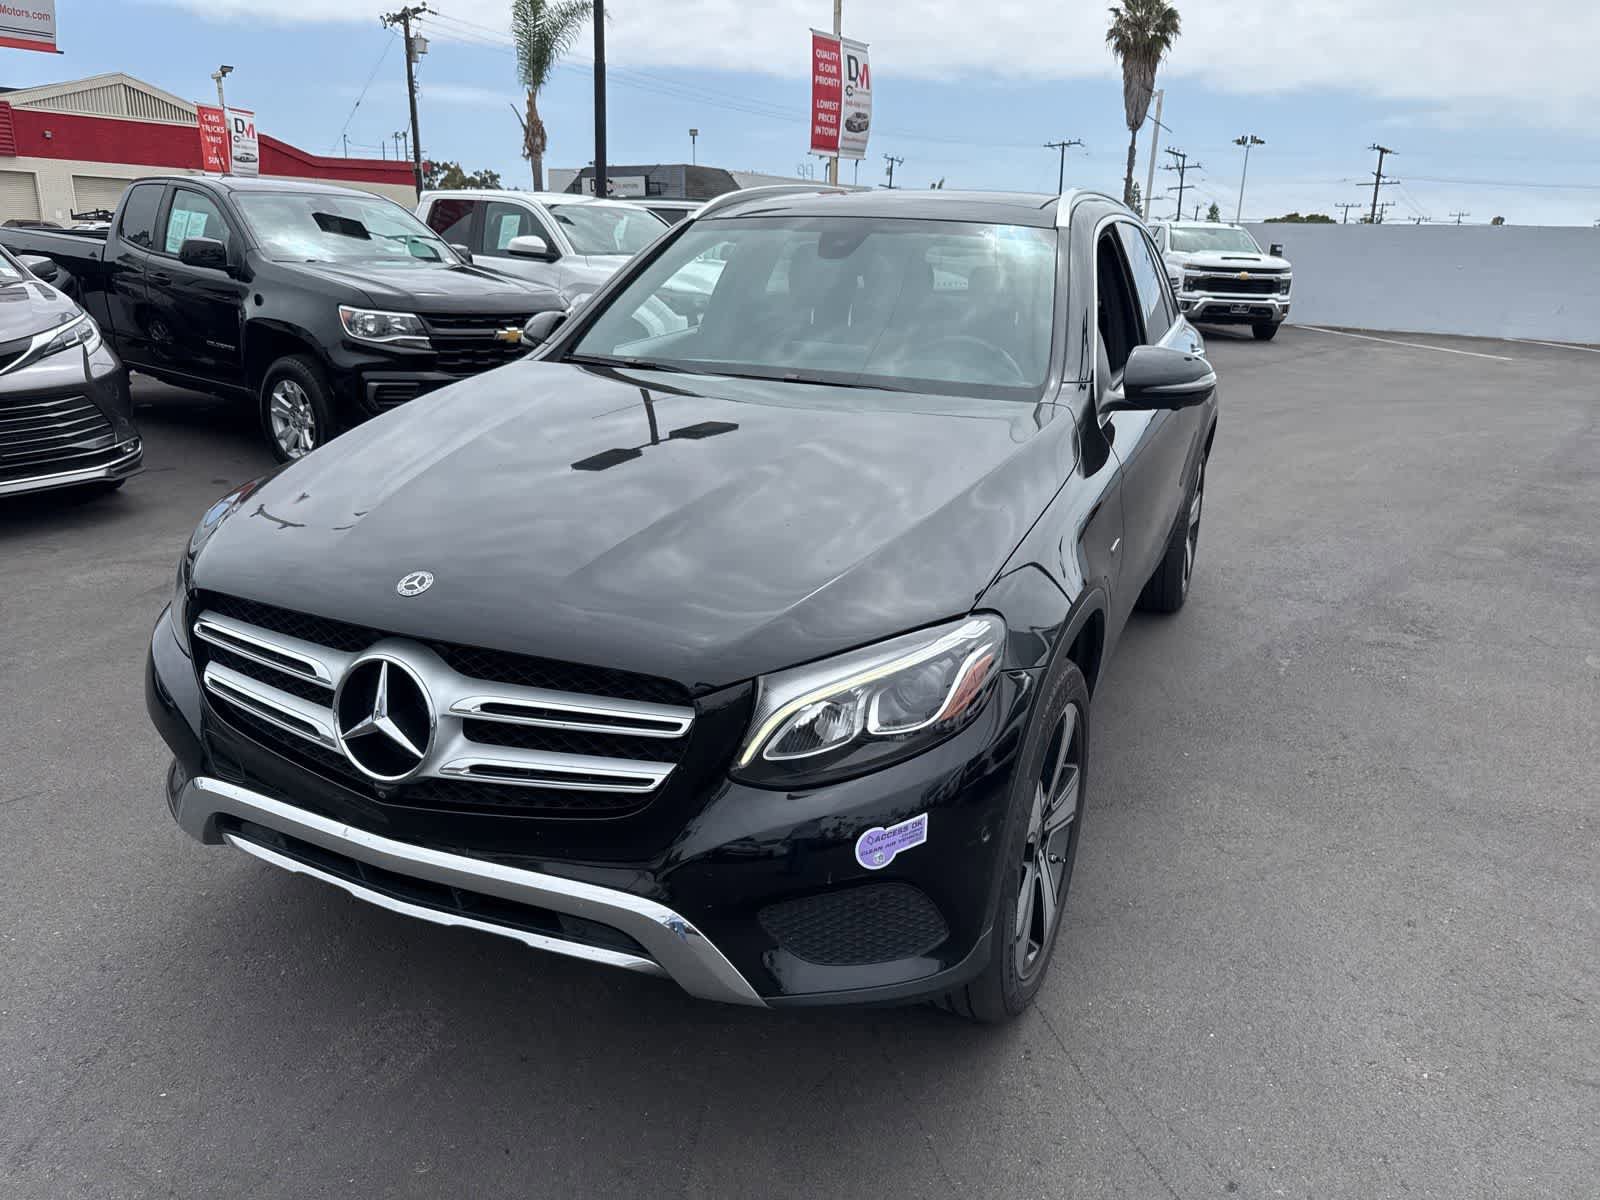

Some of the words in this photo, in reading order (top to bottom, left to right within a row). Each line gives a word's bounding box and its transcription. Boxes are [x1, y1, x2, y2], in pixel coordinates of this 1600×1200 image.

[816, 49, 839, 61] QUALITY
[819, 62, 824, 72] IS
[825, 63, 837, 74] OUR
[815, 76, 840, 88] PRIORITY
[816, 99, 840, 111] LOWEST
[203, 113, 220, 123] CARS
[818, 112, 836, 123] PRICES
[201, 124, 225, 134] TRUCKS
[815, 126, 820, 134] IN
[821, 126, 837, 137] TOWN
[874, 825, 909, 843] ACCESS
[911, 818, 924, 829] OK
